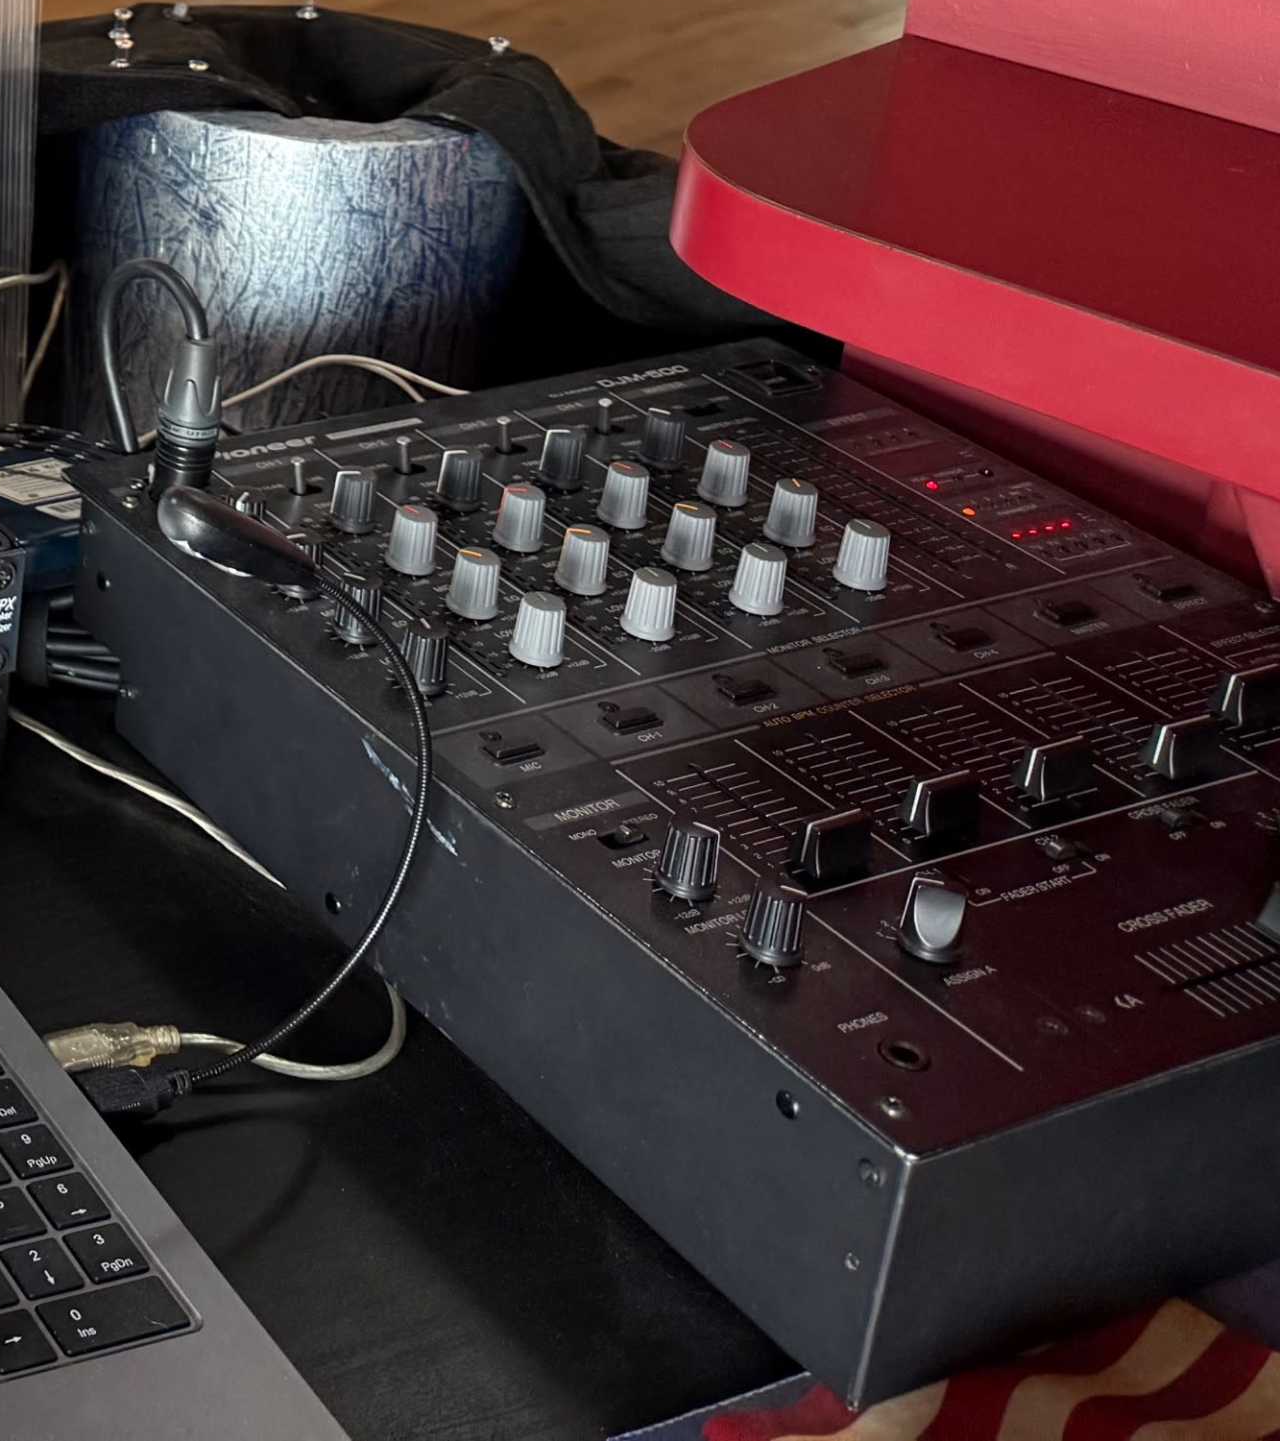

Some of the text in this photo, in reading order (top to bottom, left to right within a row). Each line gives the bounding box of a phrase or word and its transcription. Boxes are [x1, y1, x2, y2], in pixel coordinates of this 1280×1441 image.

[519, 761, 542, 773] MIC
[554, 797, 621, 822] MONITOR
[569, 828, 597, 841] MONO
[1118, 898, 1215, 934] CROSS FADER
[837, 1012, 889, 1033] PHONES
[26, 1154, 58, 1169] PgUp
[100, 1256, 134, 1273] PgDn
[77, 1326, 97, 1338] Ins
